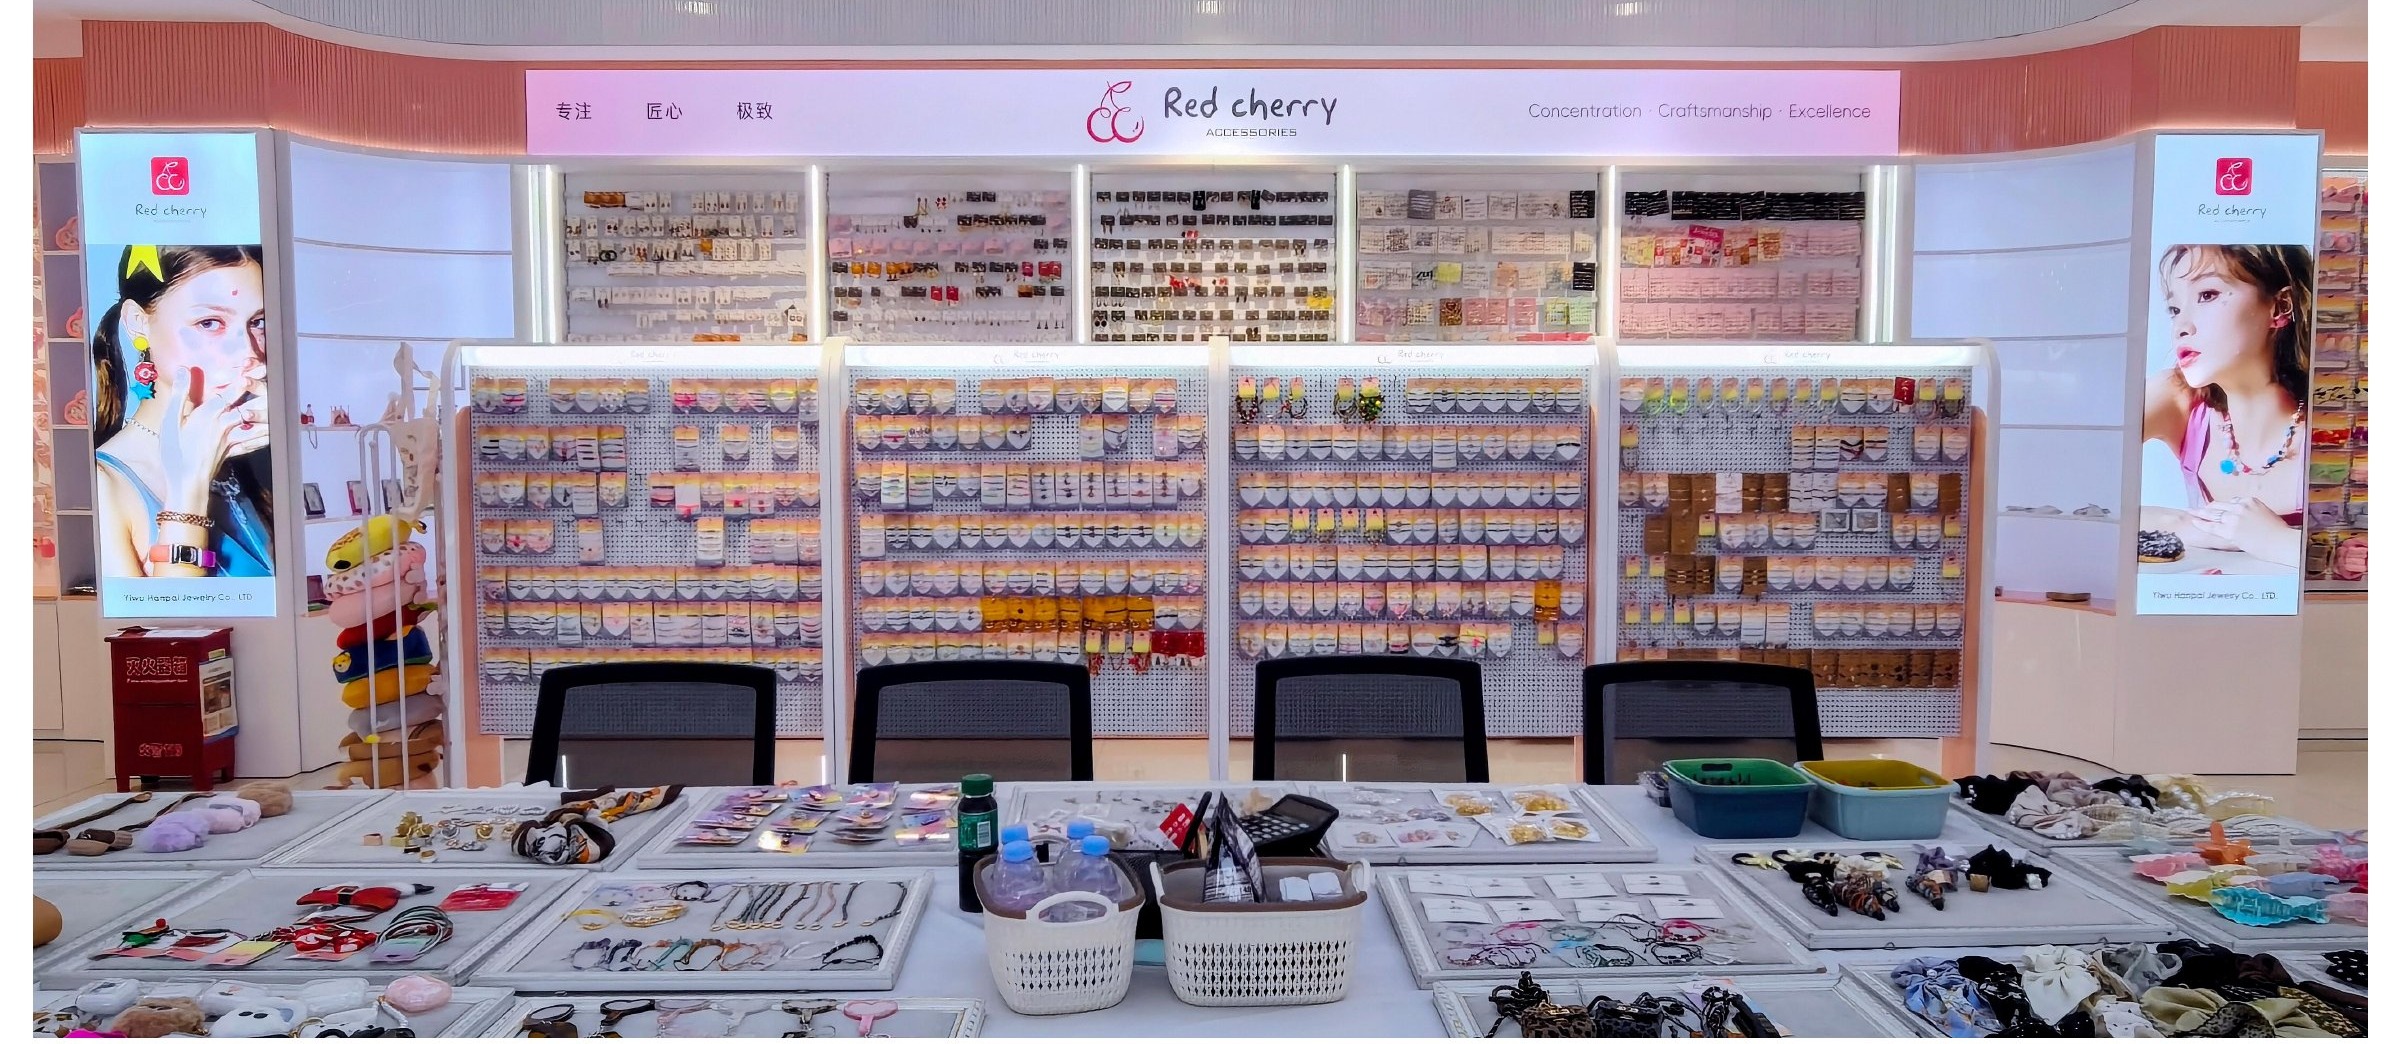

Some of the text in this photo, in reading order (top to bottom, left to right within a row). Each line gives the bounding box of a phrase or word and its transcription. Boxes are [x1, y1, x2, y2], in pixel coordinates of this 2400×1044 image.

[555, 101, 773, 121] 专注 匠心 极致
[1164, 85, 1337, 126] Red cherry
[1528, 103, 1871, 121] Concentration Craftsmanship Excellence
[1206, 128, 1297, 137] ACCESSORIES
[135, 203, 207, 219] Red cherry
[2198, 203, 2267, 219] Red cherry
